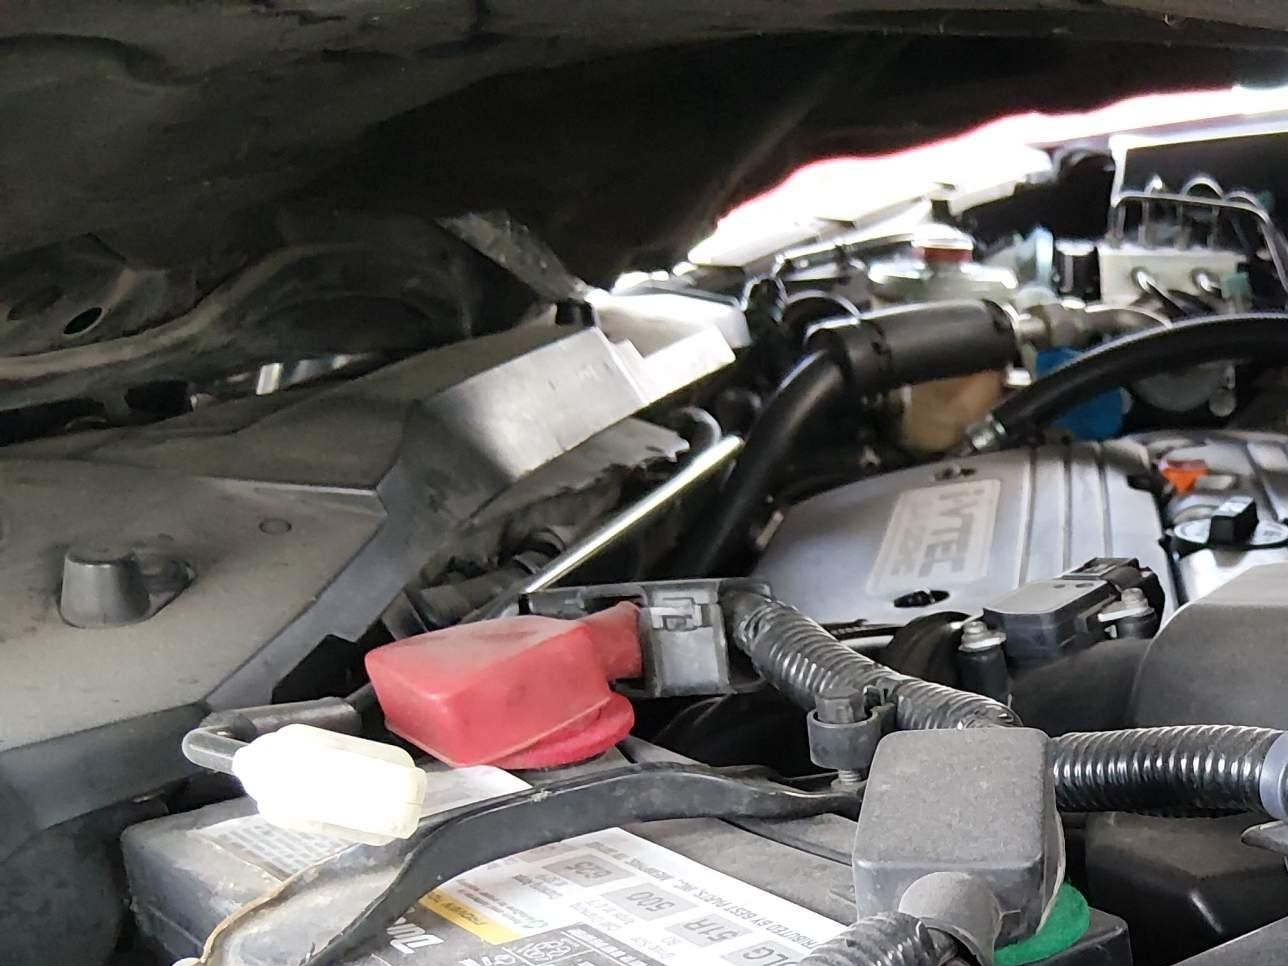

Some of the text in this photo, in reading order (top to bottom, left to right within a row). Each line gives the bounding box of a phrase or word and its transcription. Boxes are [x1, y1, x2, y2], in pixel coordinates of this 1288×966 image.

[625, 890, 674, 912] 500
[686, 917, 737, 942] 51R
[750, 917, 772, 926] BY
[766, 923, 817, 949] TRIBUTED
